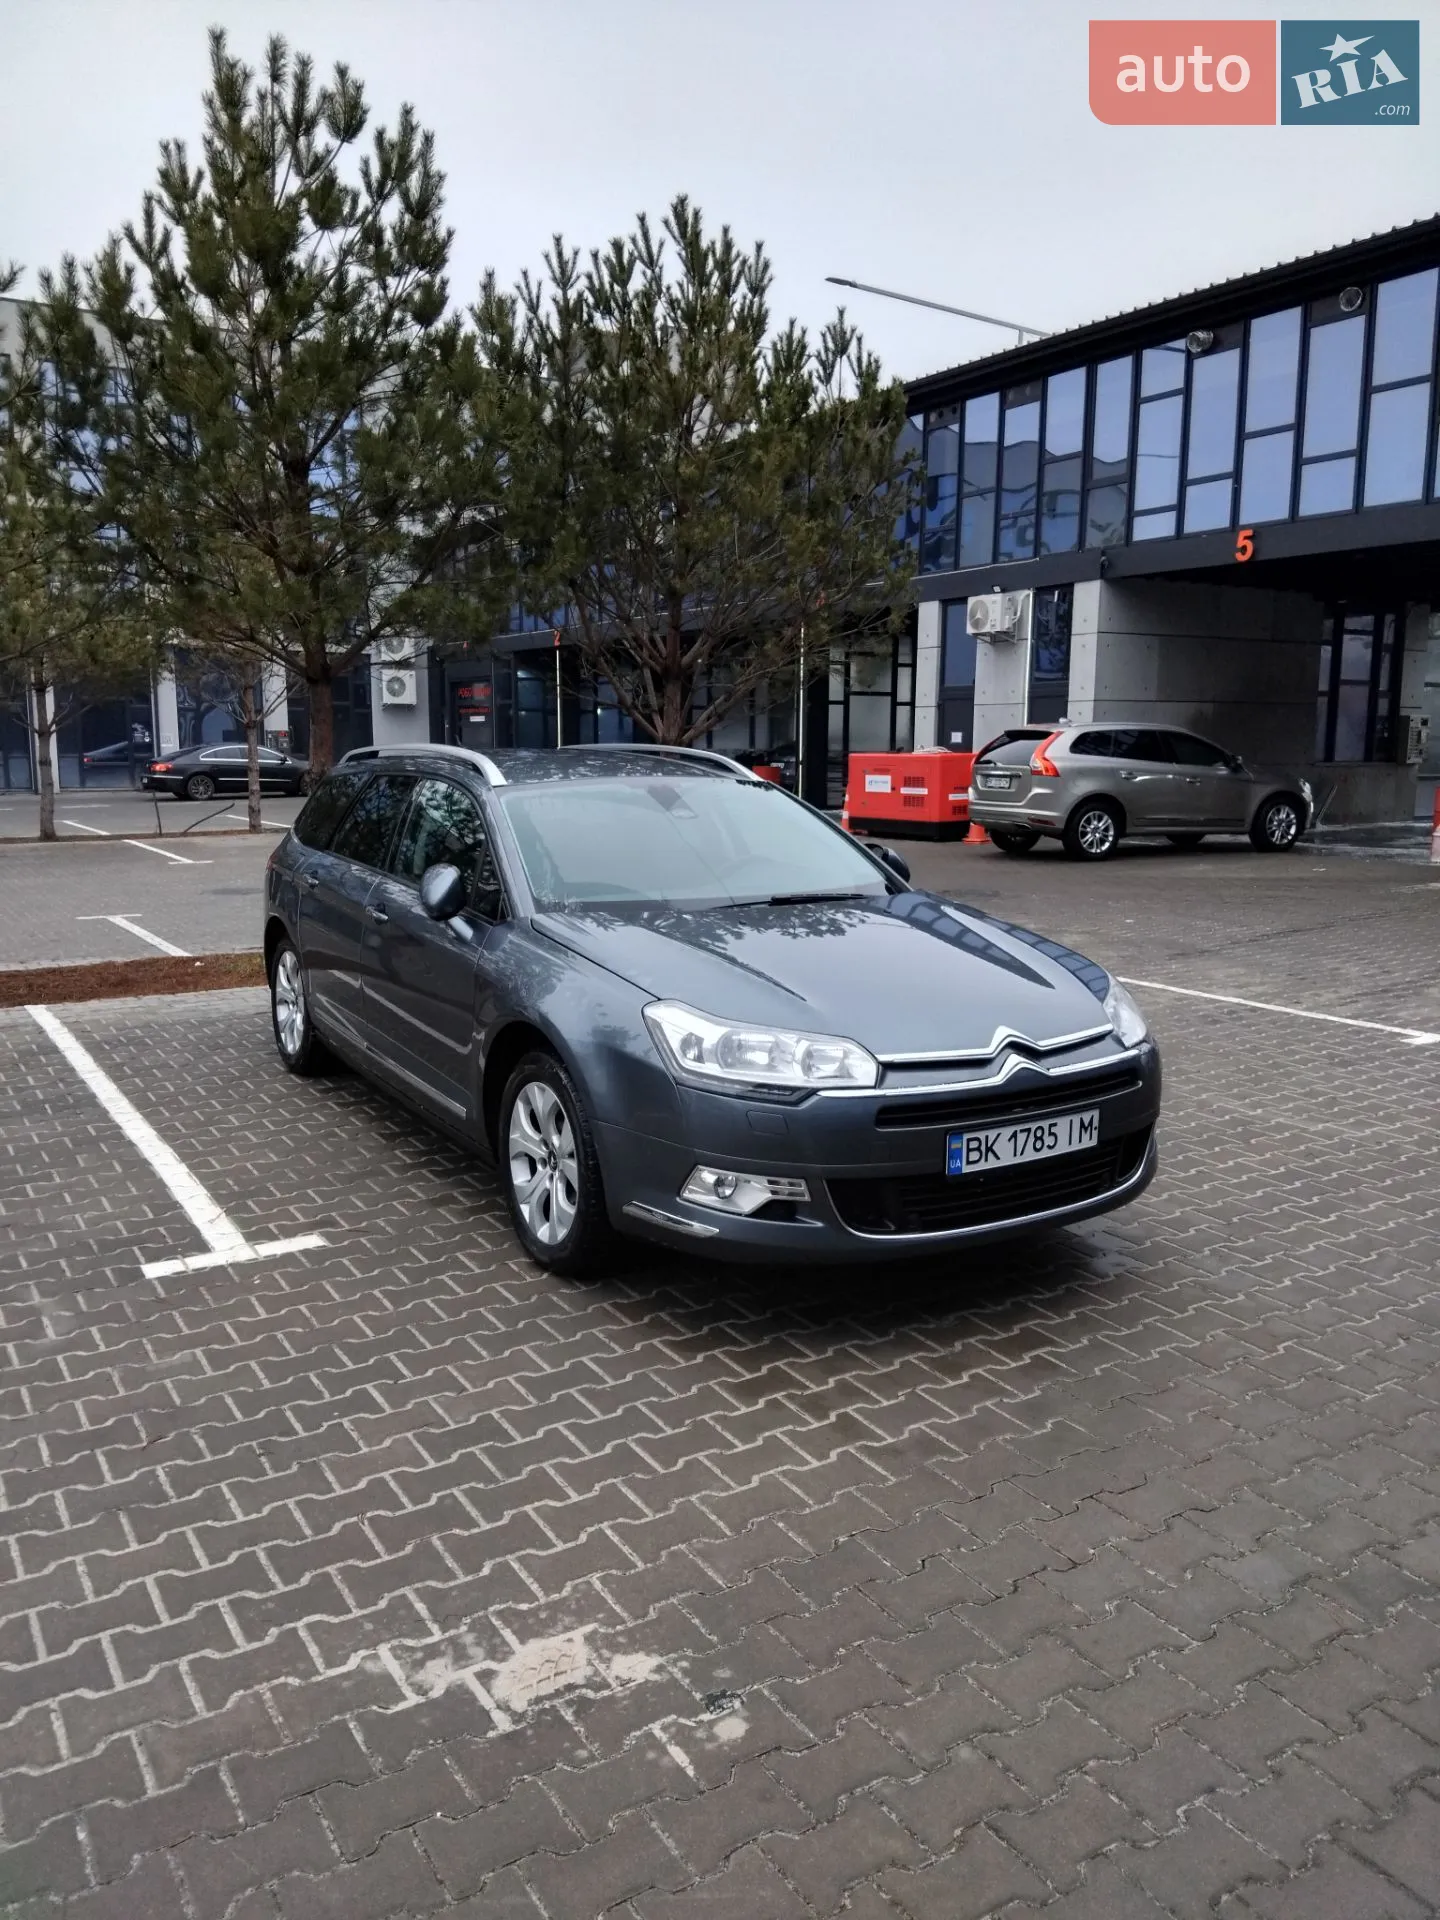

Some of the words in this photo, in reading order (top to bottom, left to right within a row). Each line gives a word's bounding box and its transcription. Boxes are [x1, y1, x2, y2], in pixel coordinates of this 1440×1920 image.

[1235, 529, 1254, 562] 5
[965, 1132, 1002, 1166] BK
[1007, 1122, 1058, 1158] 1785
[1068, 1114, 1095, 1146] IM
[949, 1158, 961, 1169] UA
